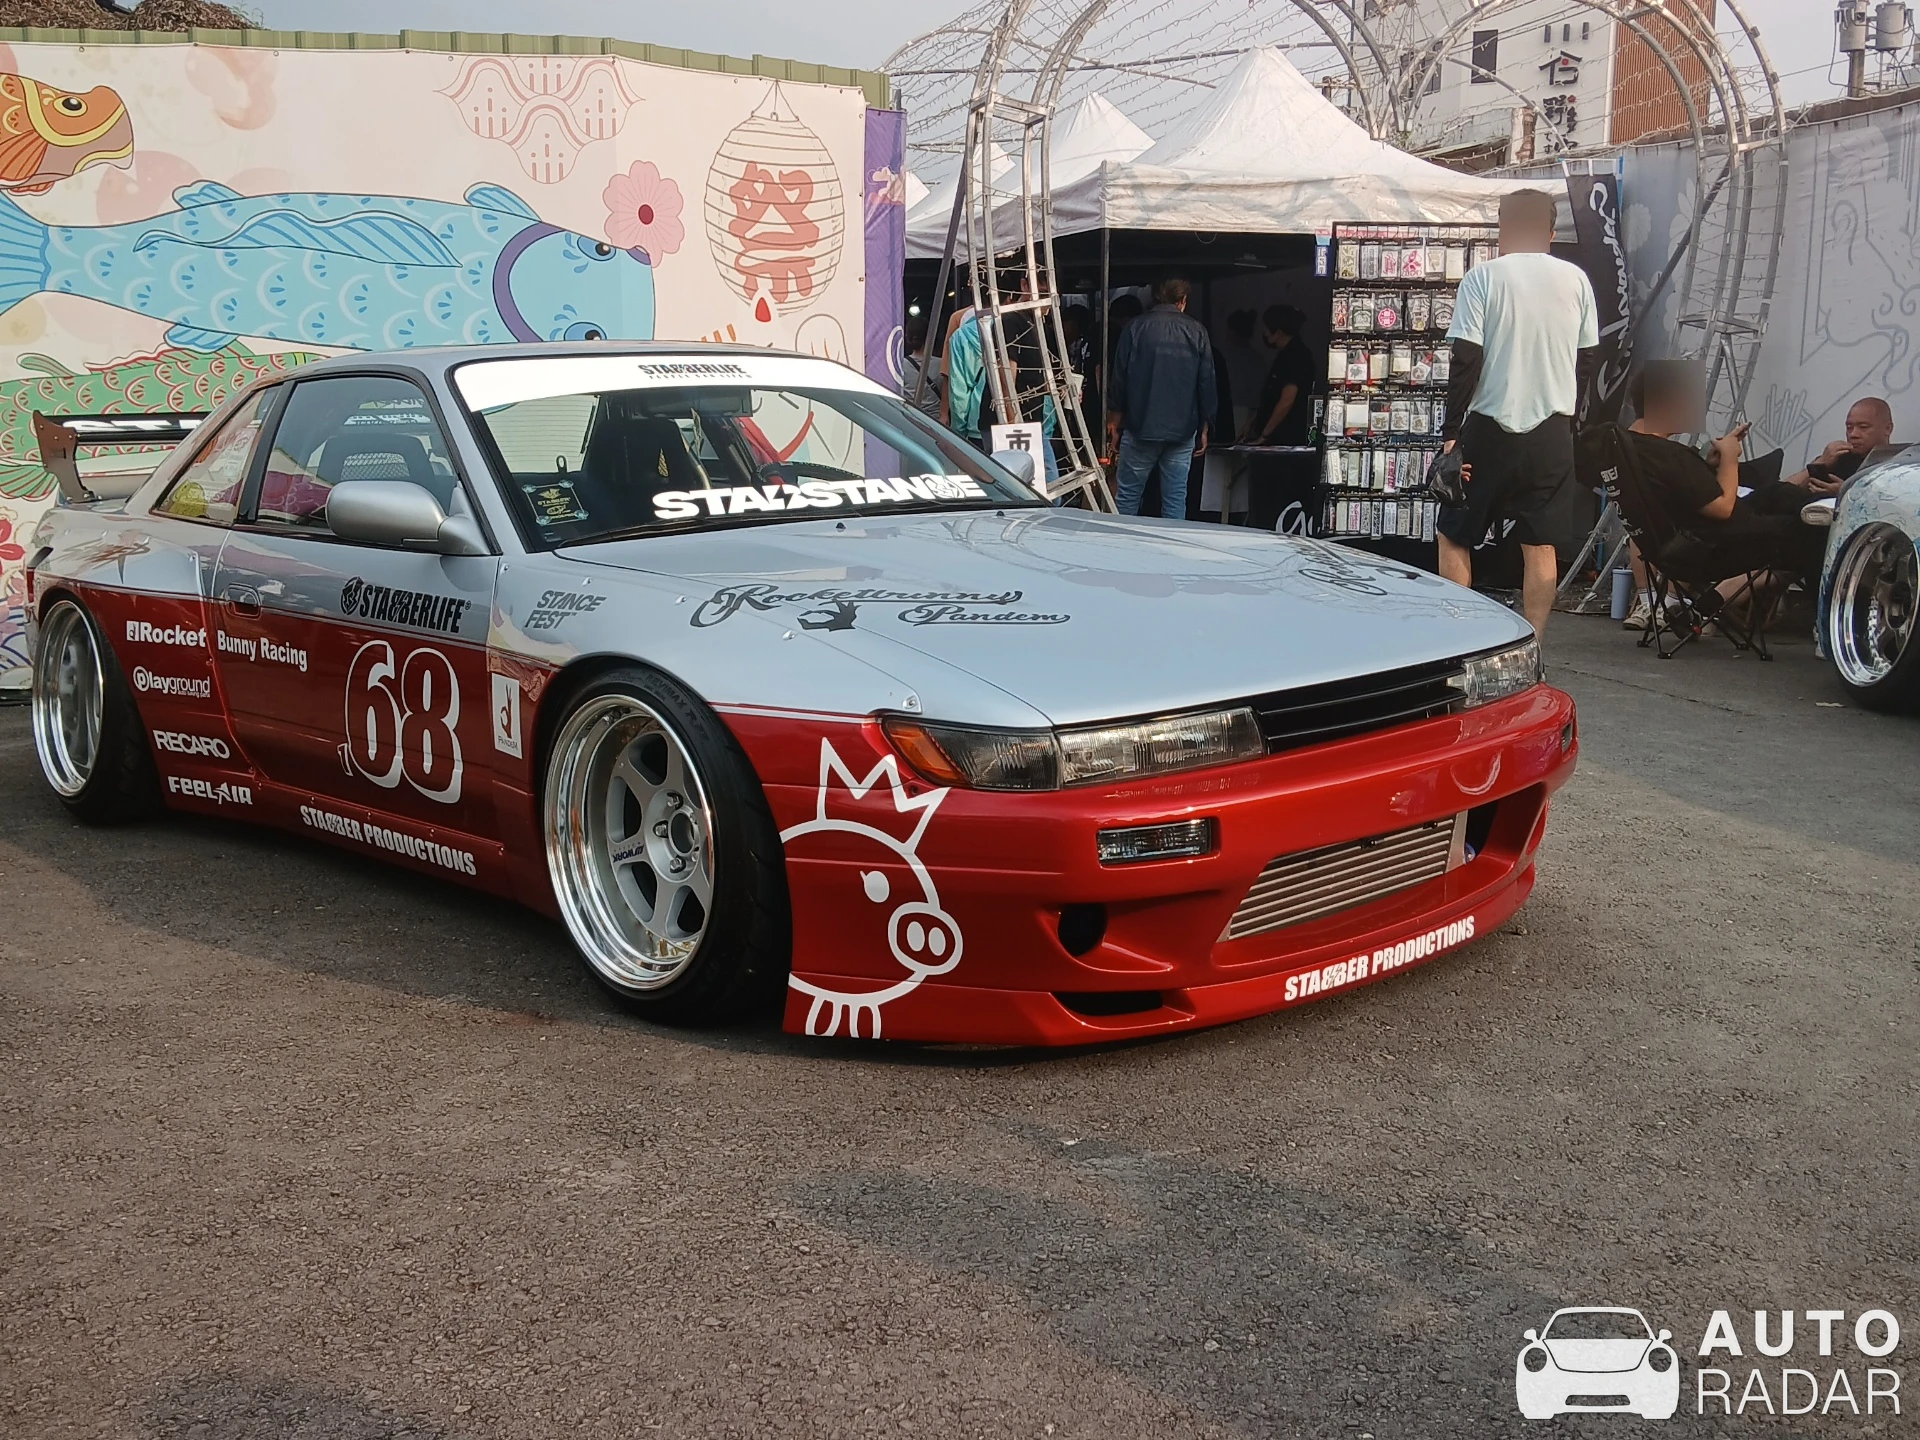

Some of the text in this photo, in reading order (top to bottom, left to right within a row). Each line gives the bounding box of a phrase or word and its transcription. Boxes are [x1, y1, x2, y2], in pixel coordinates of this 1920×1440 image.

[537, 590, 607, 612] STANCE
[897, 603, 1071, 627] Pandem
[524, 610, 566, 630] FEST
[140, 622, 308, 672] Rocket Bunny Racing
[344, 640, 463, 803] 68
[152, 729, 231, 759] RECARO
[300, 805, 477, 876] STABBER PRODUCTIONS
[612, 848, 635, 863] WORK
[1284, 915, 1475, 1001] STABBER PRODUCTIONS
